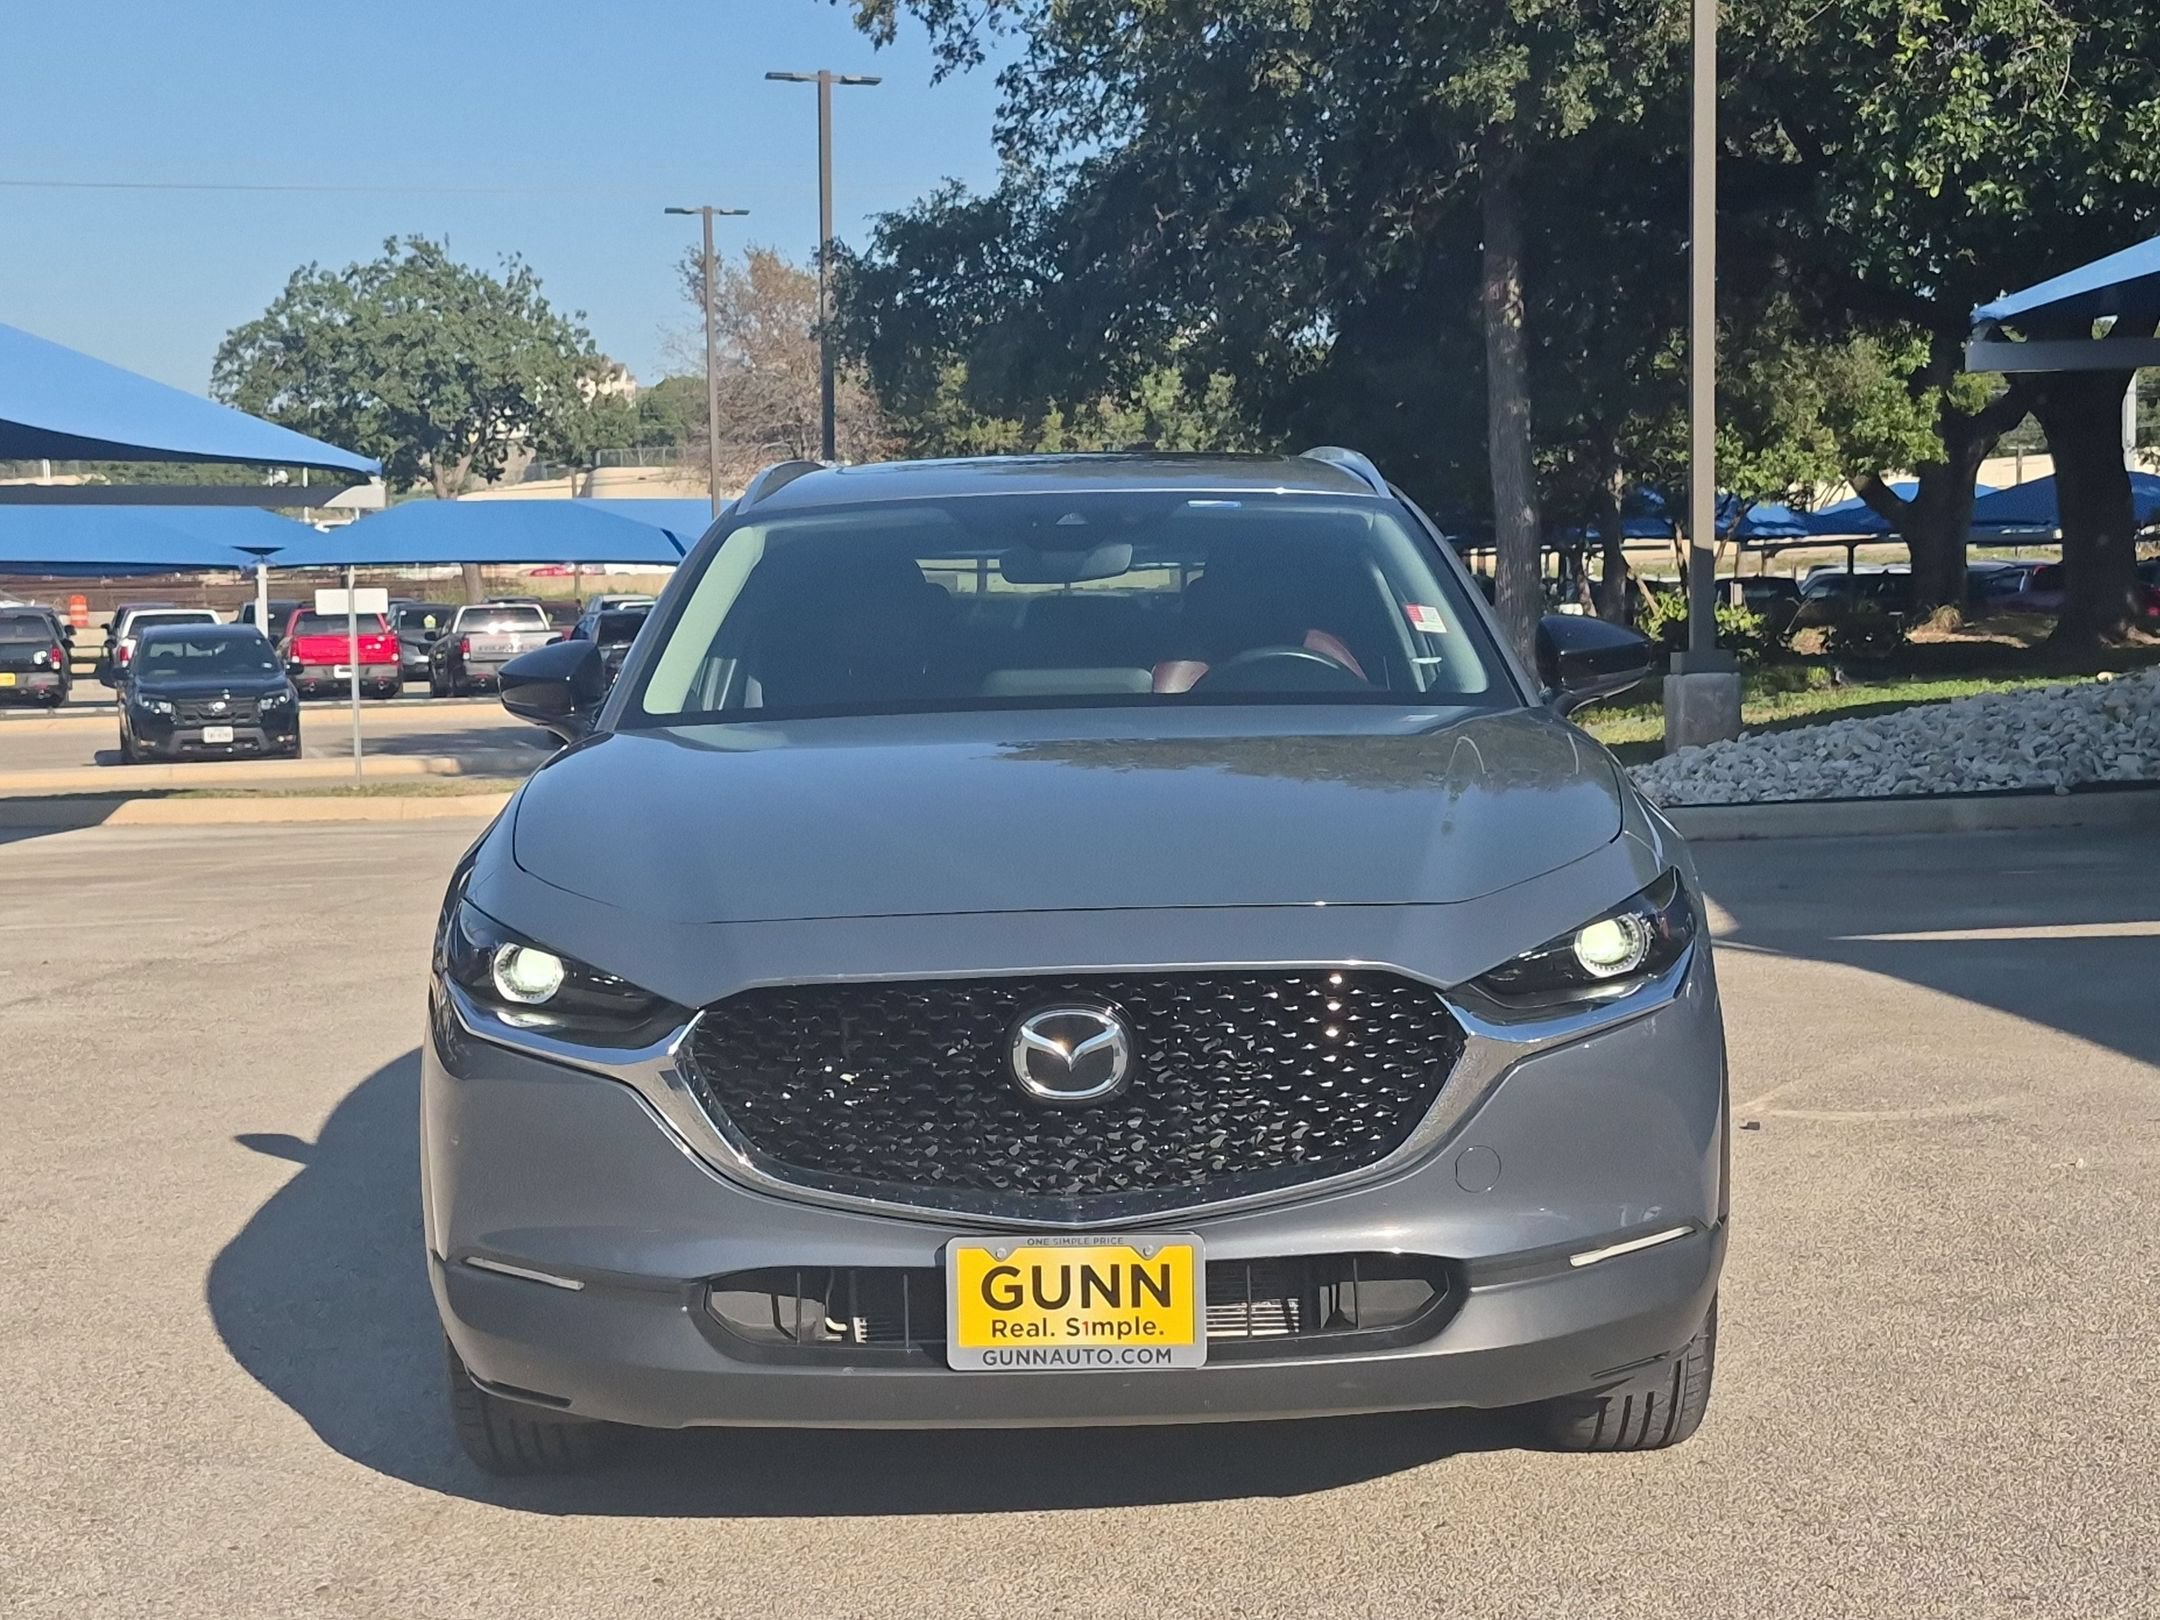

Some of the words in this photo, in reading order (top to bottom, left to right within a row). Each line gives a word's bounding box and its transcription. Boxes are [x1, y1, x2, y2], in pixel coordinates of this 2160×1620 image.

[1027, 1238, 1050, 1246] ONE
[1053, 1237, 1090, 1246] SIMPLE
[1093, 1237, 1124, 1245] PRICE
[981, 1263, 1171, 1311] GUNN
[991, 1317, 1055, 1338] Real.
[982, 1347, 1172, 1366] GUNNAUTO.COM
